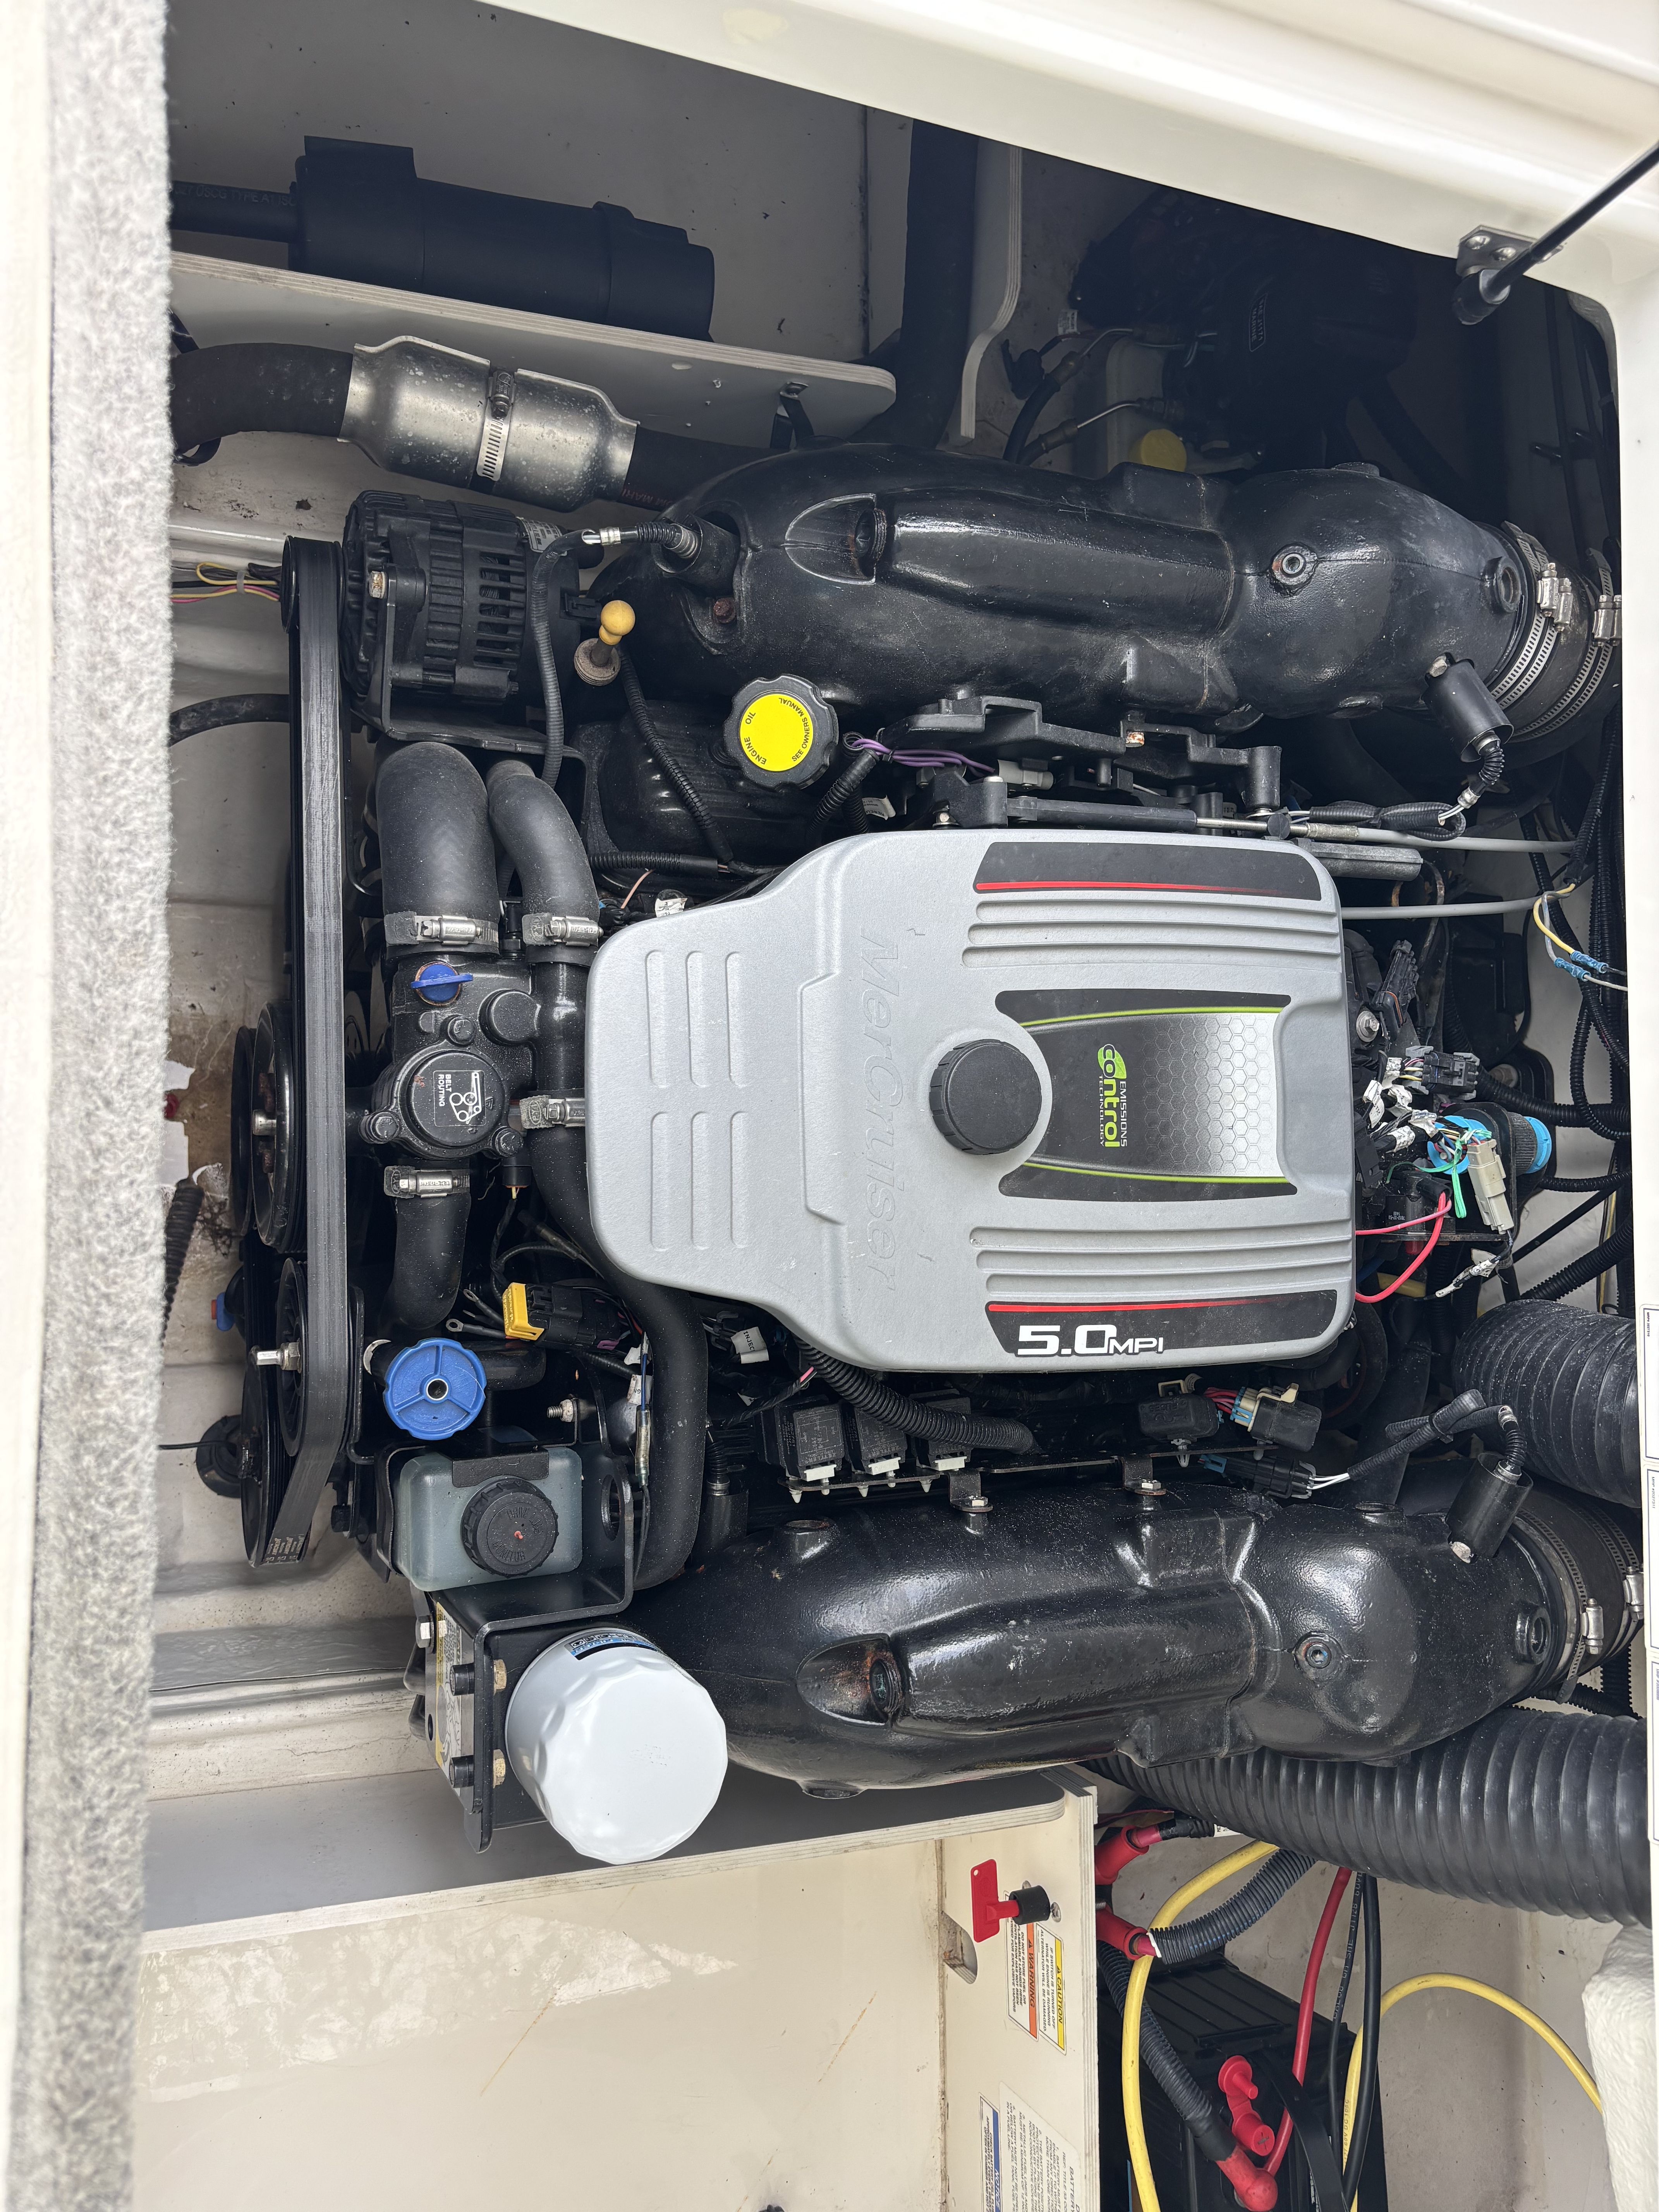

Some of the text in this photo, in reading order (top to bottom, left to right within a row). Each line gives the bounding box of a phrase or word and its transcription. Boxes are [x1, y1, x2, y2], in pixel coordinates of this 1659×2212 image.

[744, 711, 767, 765] ENGINE OIL
[778, 697, 810, 762] SEE OWNERS MANUAL
[743, 1331, 756, 1351] INJEC
[1021, 1932, 1024, 1941] DO
[1023, 1995, 1026, 2005] OR
[1042, 1989, 1046, 1998] BE
